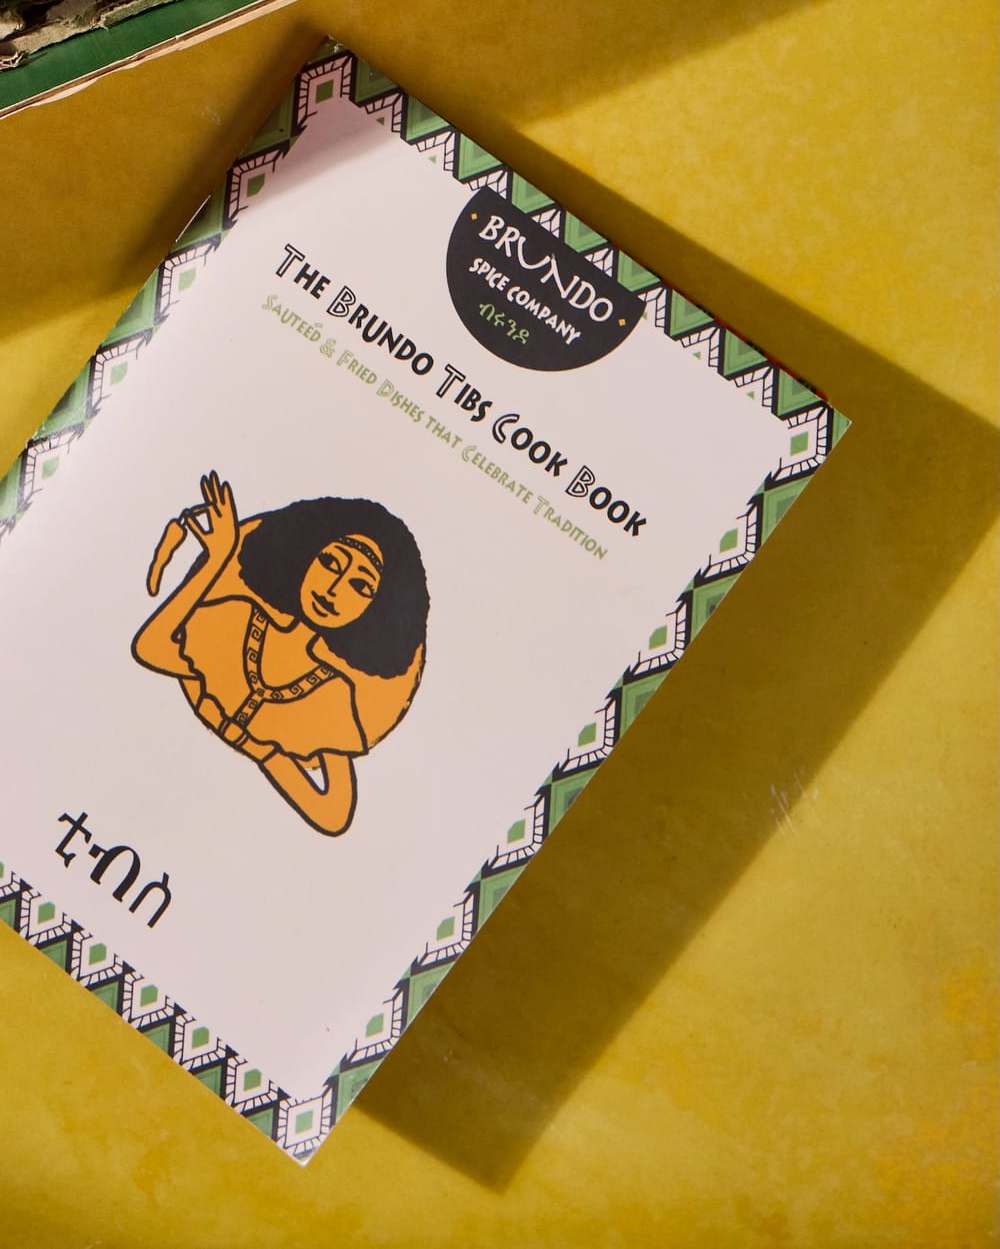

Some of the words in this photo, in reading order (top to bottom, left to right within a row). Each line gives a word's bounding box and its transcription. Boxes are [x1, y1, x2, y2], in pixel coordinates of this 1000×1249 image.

[469, 258, 510, 291] SPICE
[506, 286, 581, 345] COMPANY
[479, 215, 614, 322] BRUNDO
[319, 338, 336, 358] &
